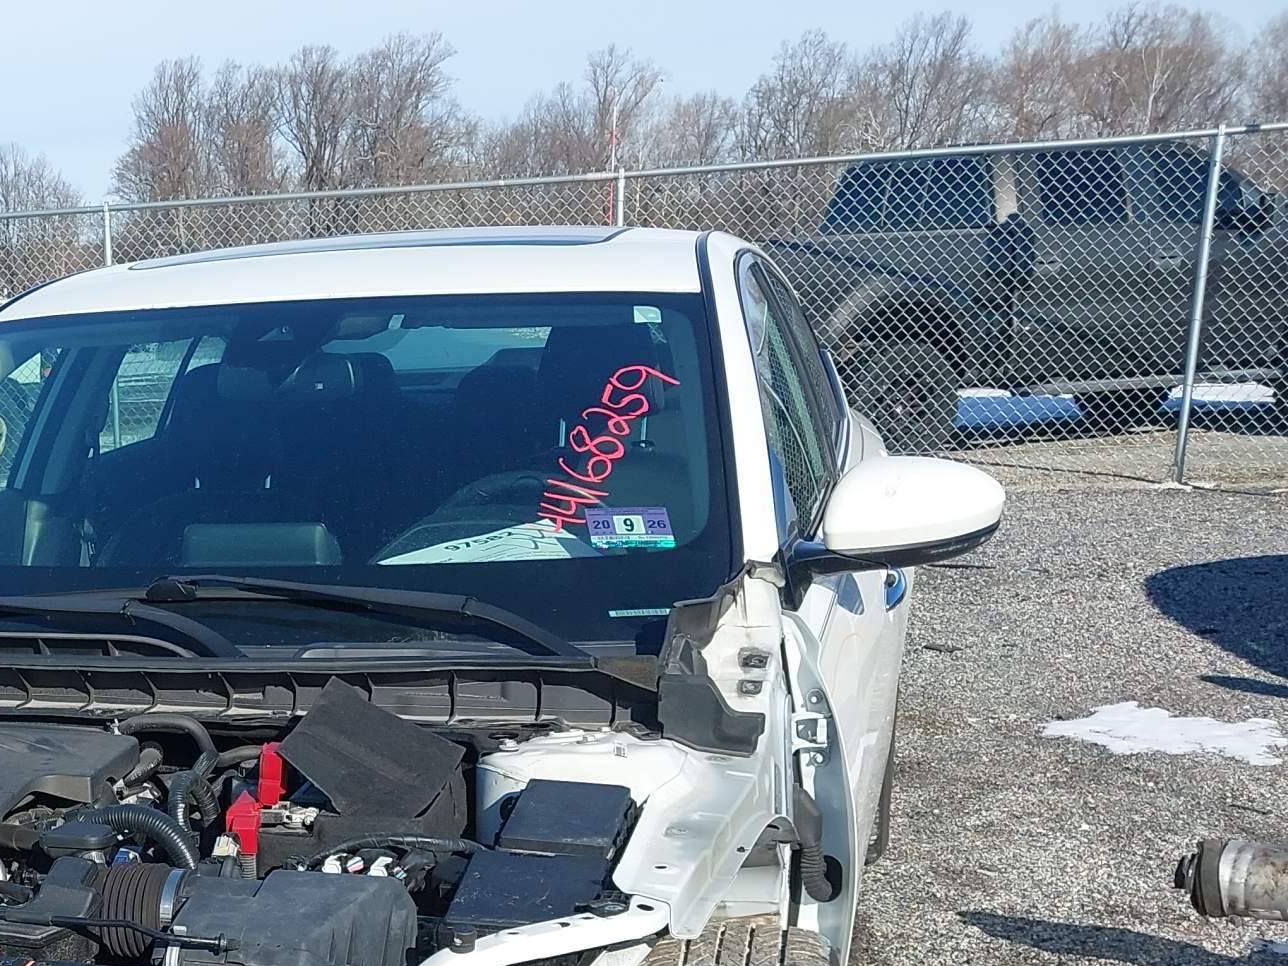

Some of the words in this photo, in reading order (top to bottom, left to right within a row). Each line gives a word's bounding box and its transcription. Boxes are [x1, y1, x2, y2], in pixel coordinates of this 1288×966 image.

[537, 365, 681, 533] 44168259
[592, 519, 611, 530] 20
[623, 517, 635, 532] 9
[648, 519, 667, 529] 26
